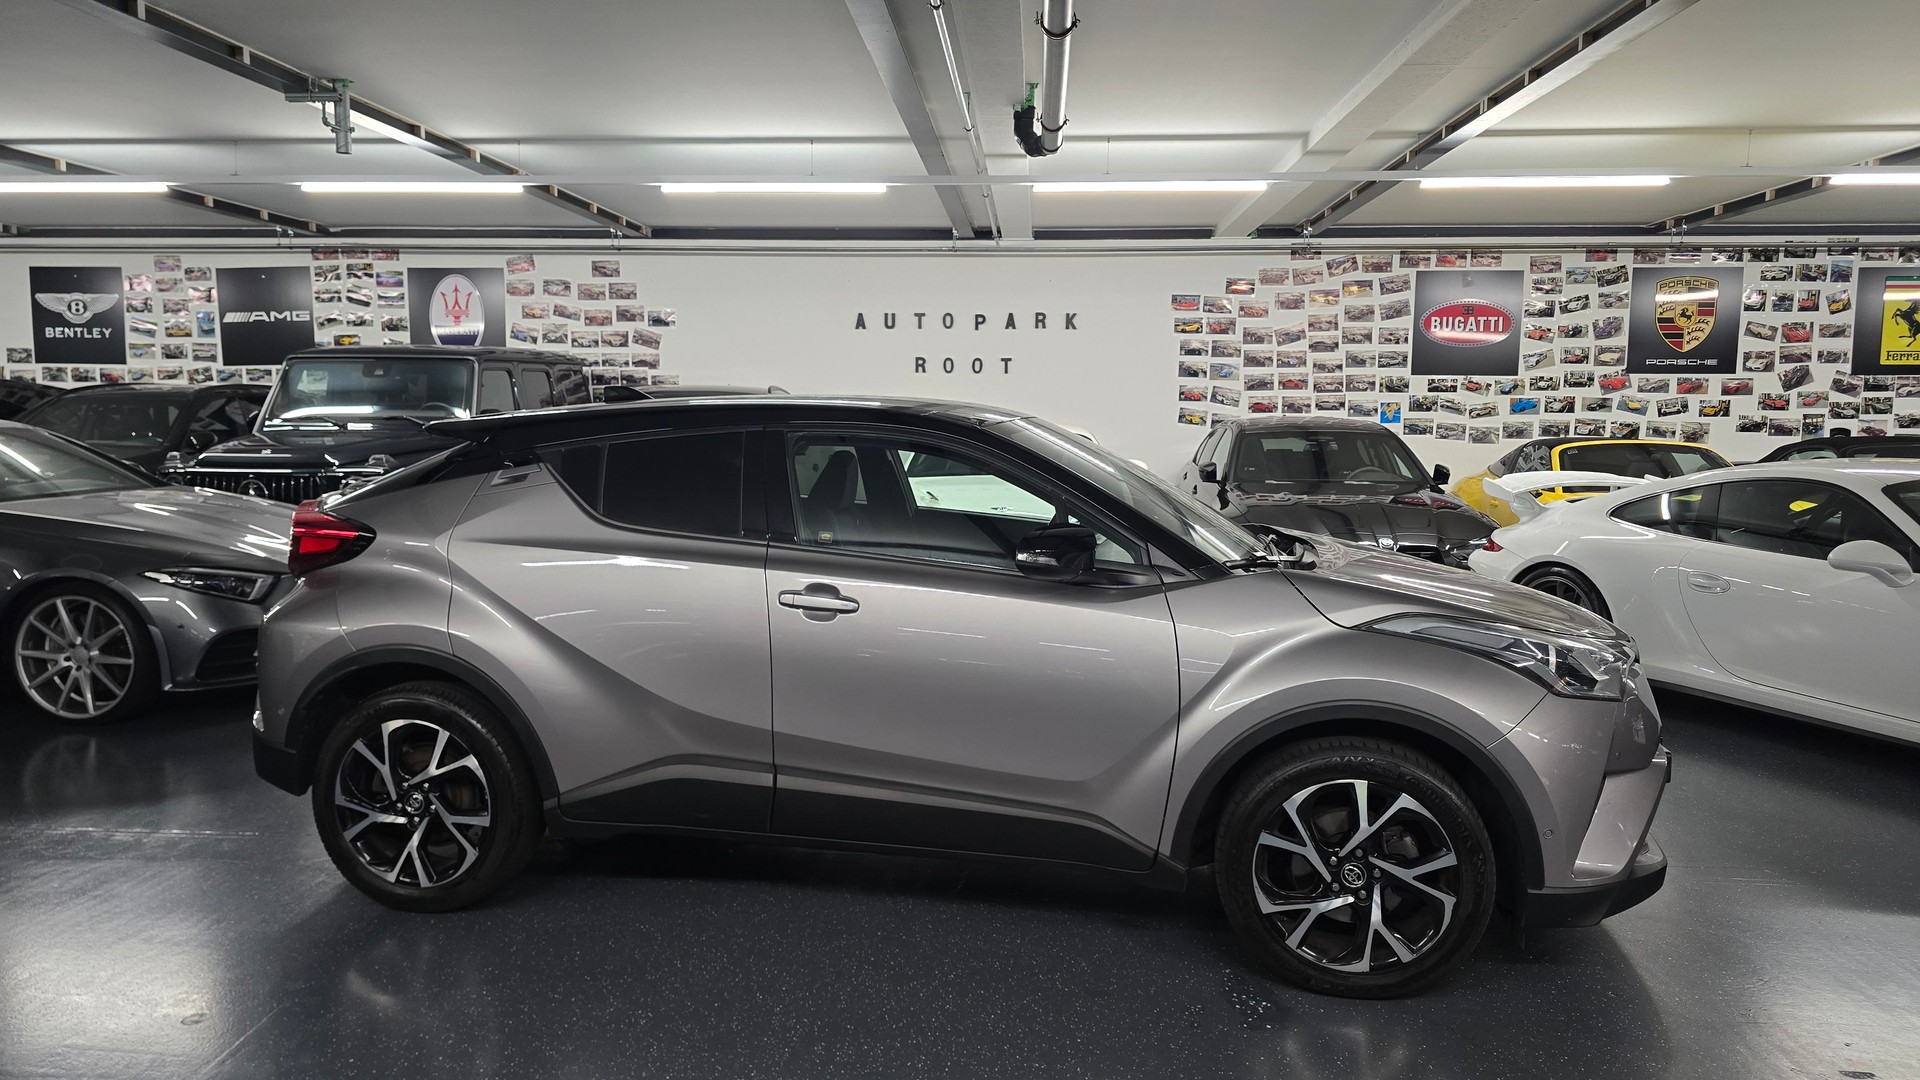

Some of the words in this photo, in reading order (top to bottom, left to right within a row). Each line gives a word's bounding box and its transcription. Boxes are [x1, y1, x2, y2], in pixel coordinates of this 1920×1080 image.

[1660, 280, 1715, 291] PORSCHE
[249, 310, 311, 322] AMG
[855, 312, 1078, 331] AUTOPARK
[1430, 316, 1504, 332] BUGATTI
[45, 327, 112, 338] BENTLEY
[915, 357, 1013, 374] ROOT
